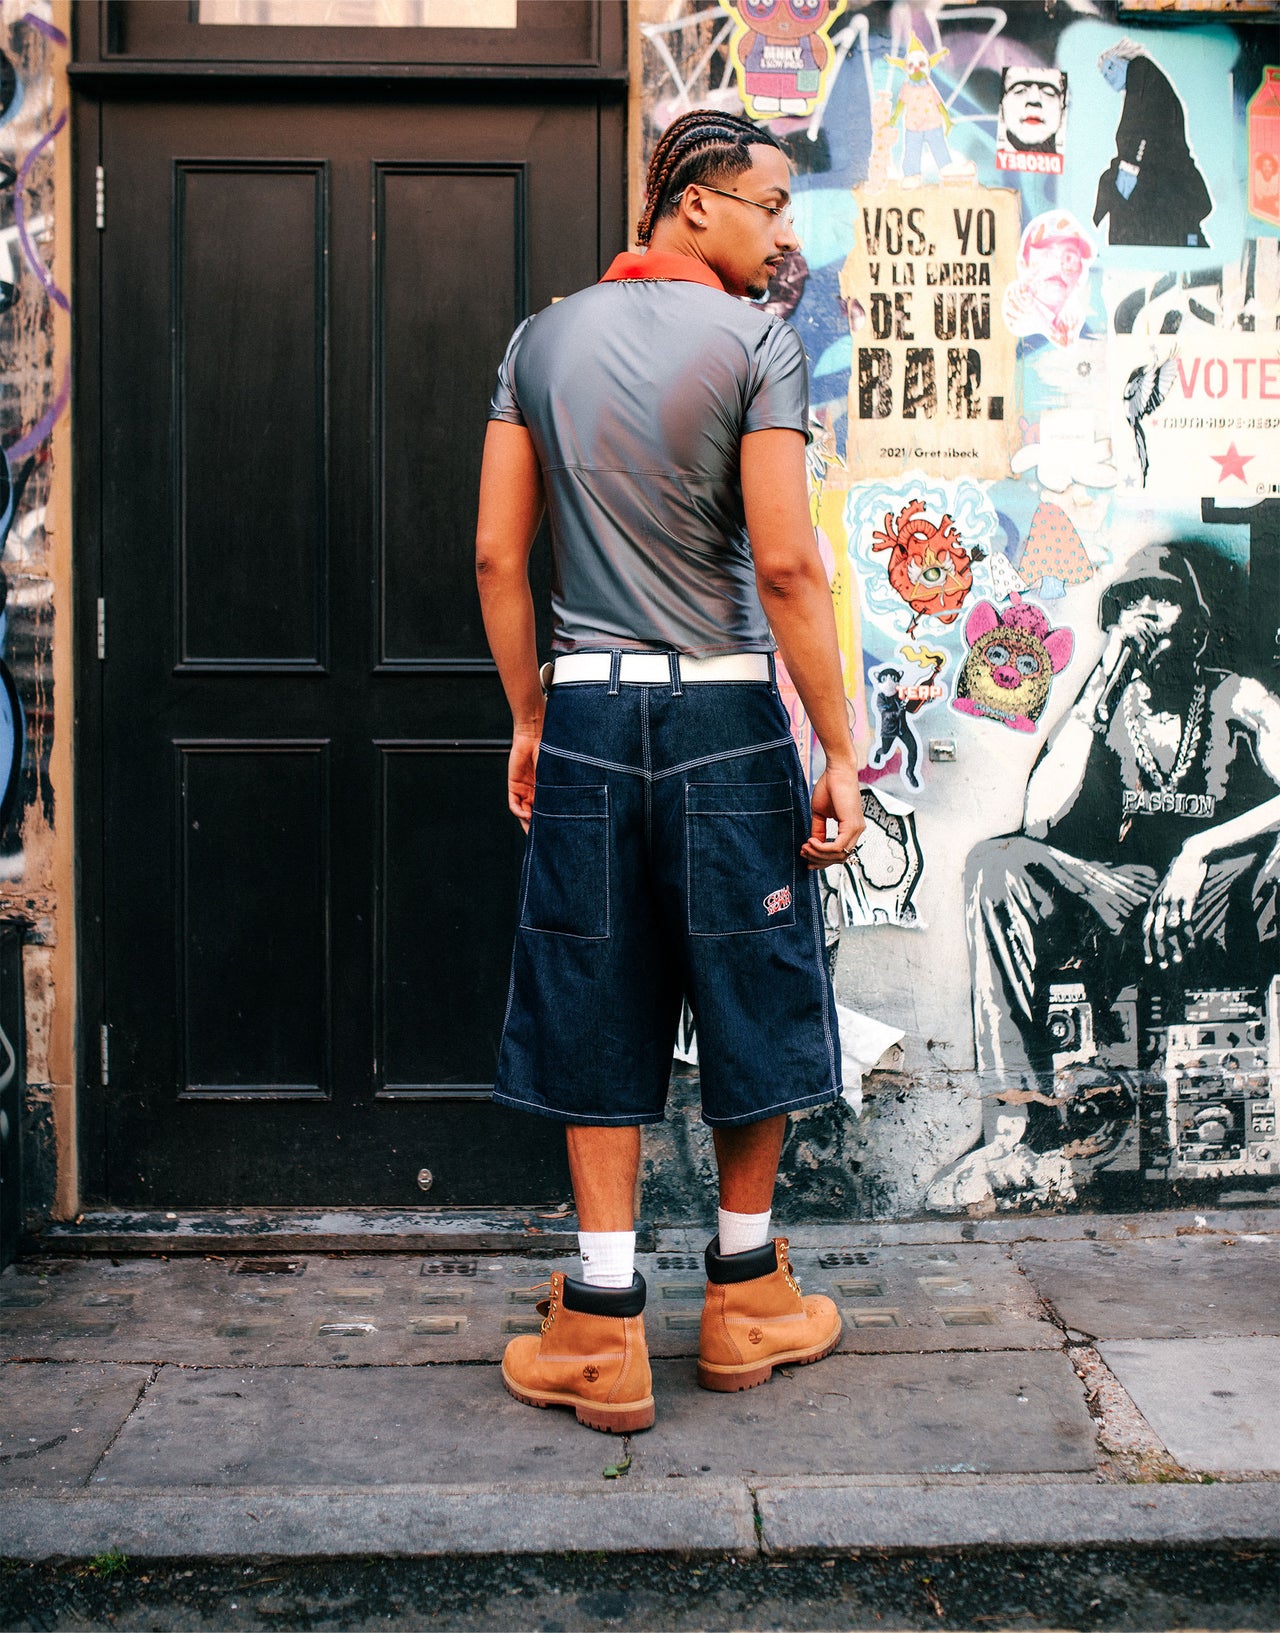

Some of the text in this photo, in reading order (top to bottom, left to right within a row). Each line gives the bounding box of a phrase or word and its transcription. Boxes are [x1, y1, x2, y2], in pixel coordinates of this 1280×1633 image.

[953, 207, 996, 256] YO
[869, 262, 991, 286] Y LA BARRA
[870, 292, 991, 341] DE UN
[858, 347, 1004, 421] BAR.
[1176, 357, 1280, 400] VOTE
[880, 447, 905, 458] 2021
[1123, 790, 1214, 816] PASSION
